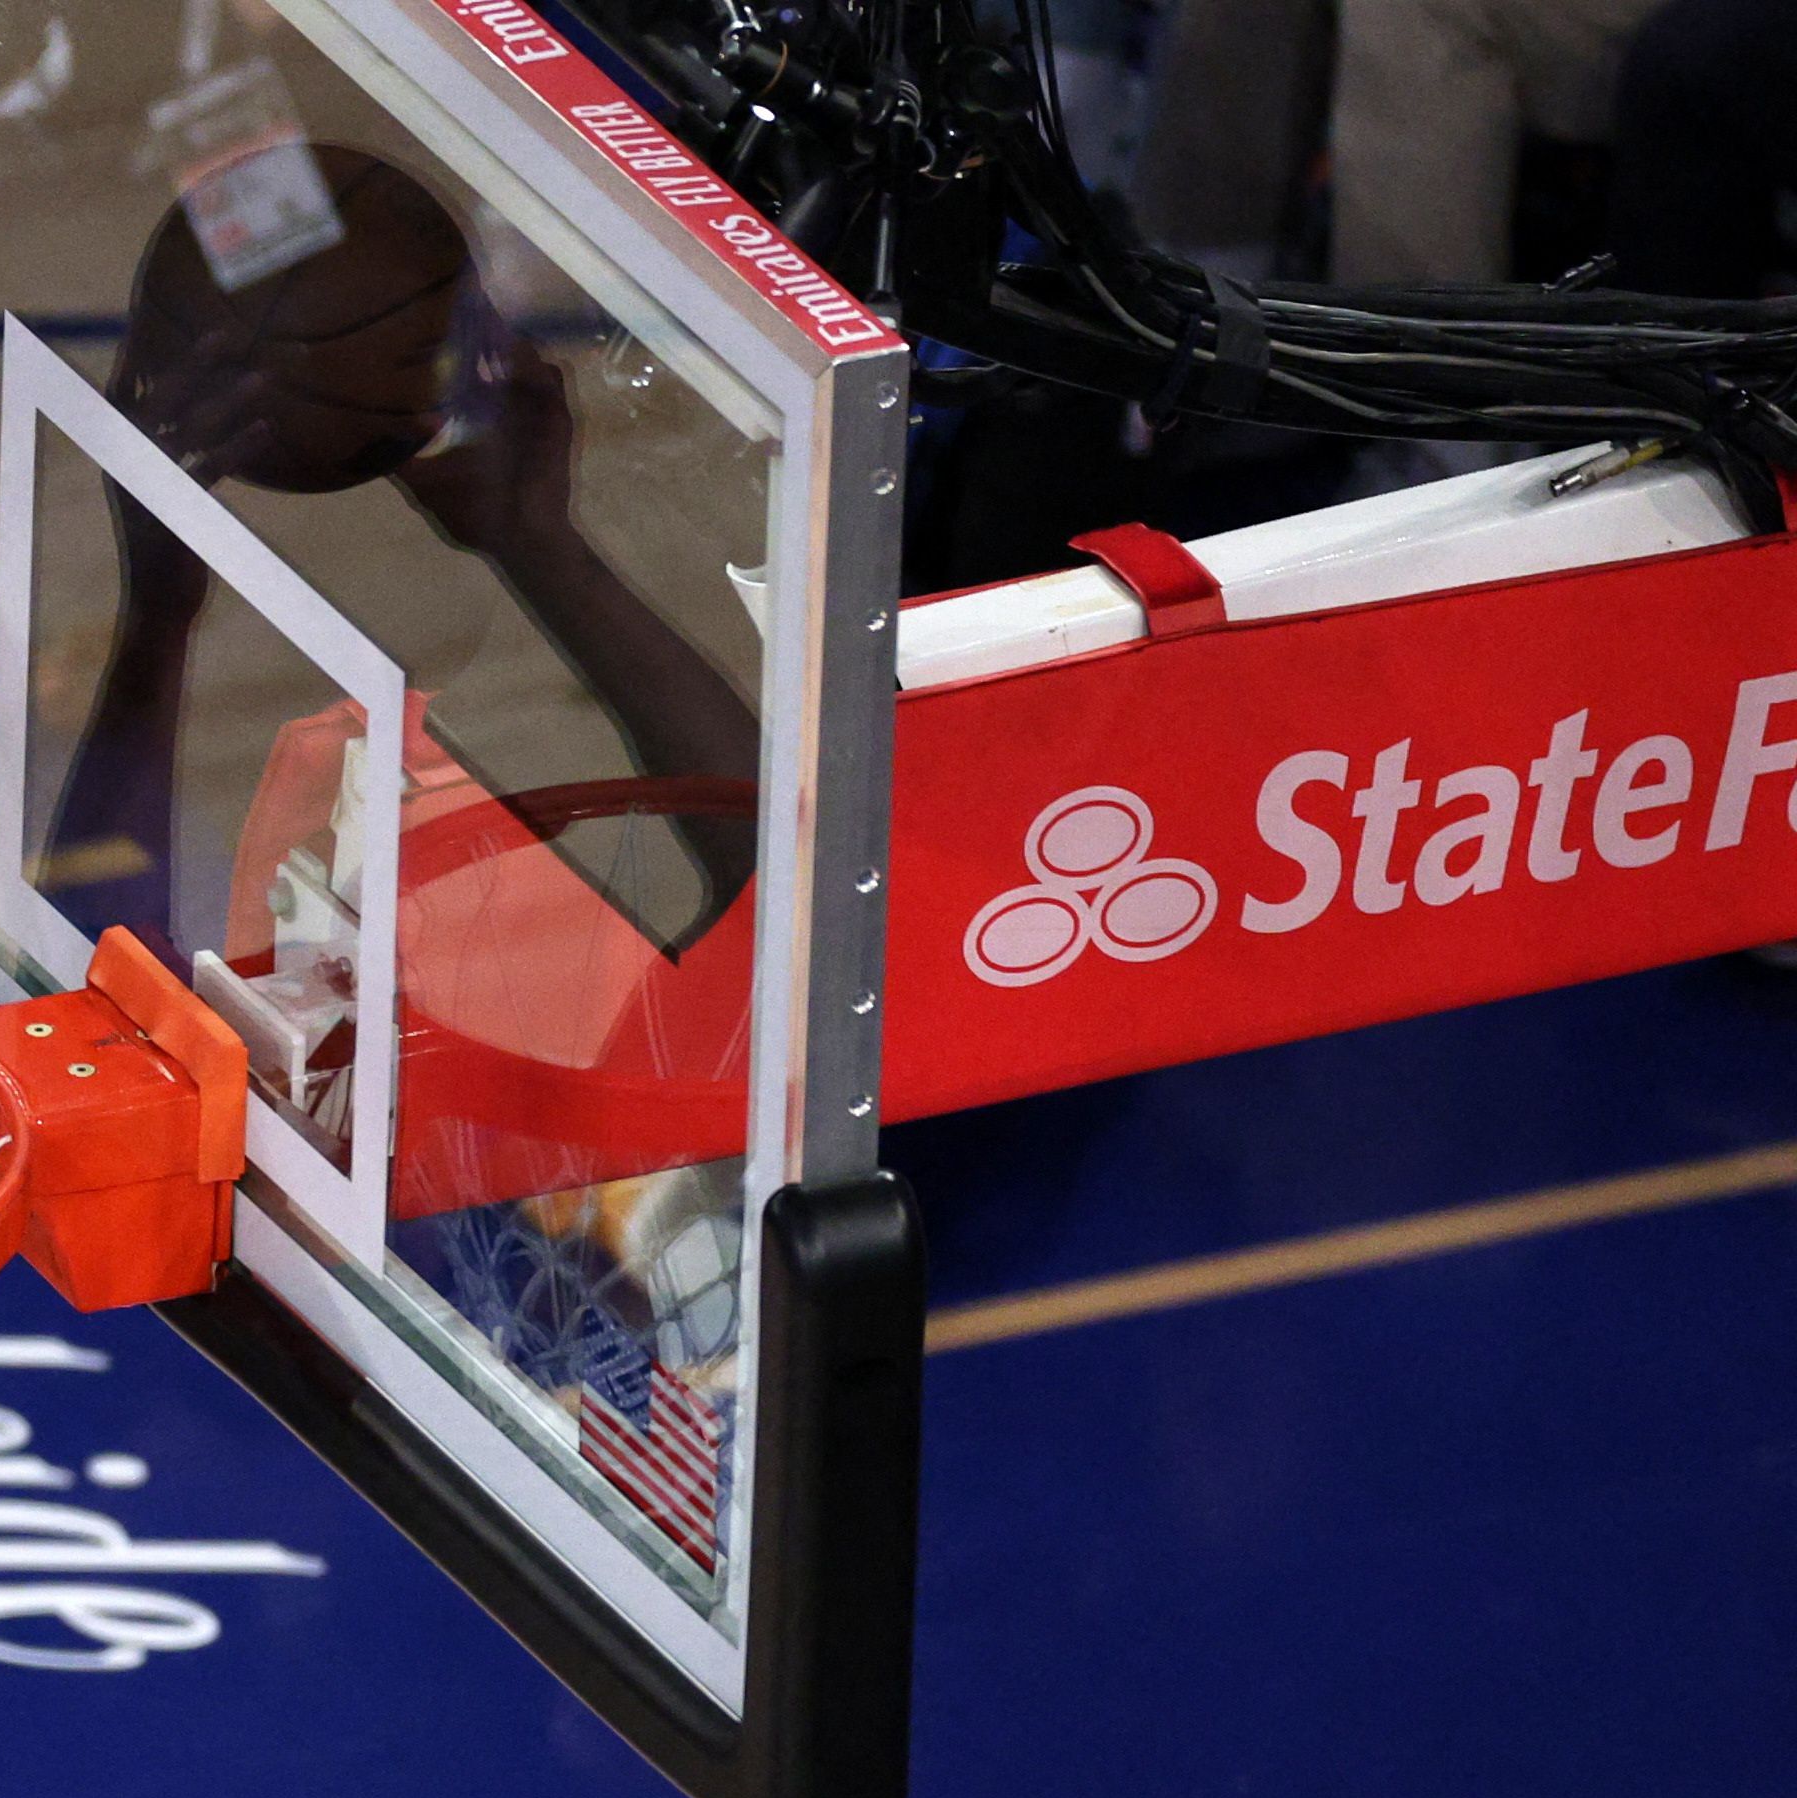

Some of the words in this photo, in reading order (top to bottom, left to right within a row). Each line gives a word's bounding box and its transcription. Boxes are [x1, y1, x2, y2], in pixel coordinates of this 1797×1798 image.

[457, 0, 570, 64] Emi
[570, 101, 694, 171] BETTER
[647, 175, 734, 207] FLY
[708, 214, 884, 346] Emirates
